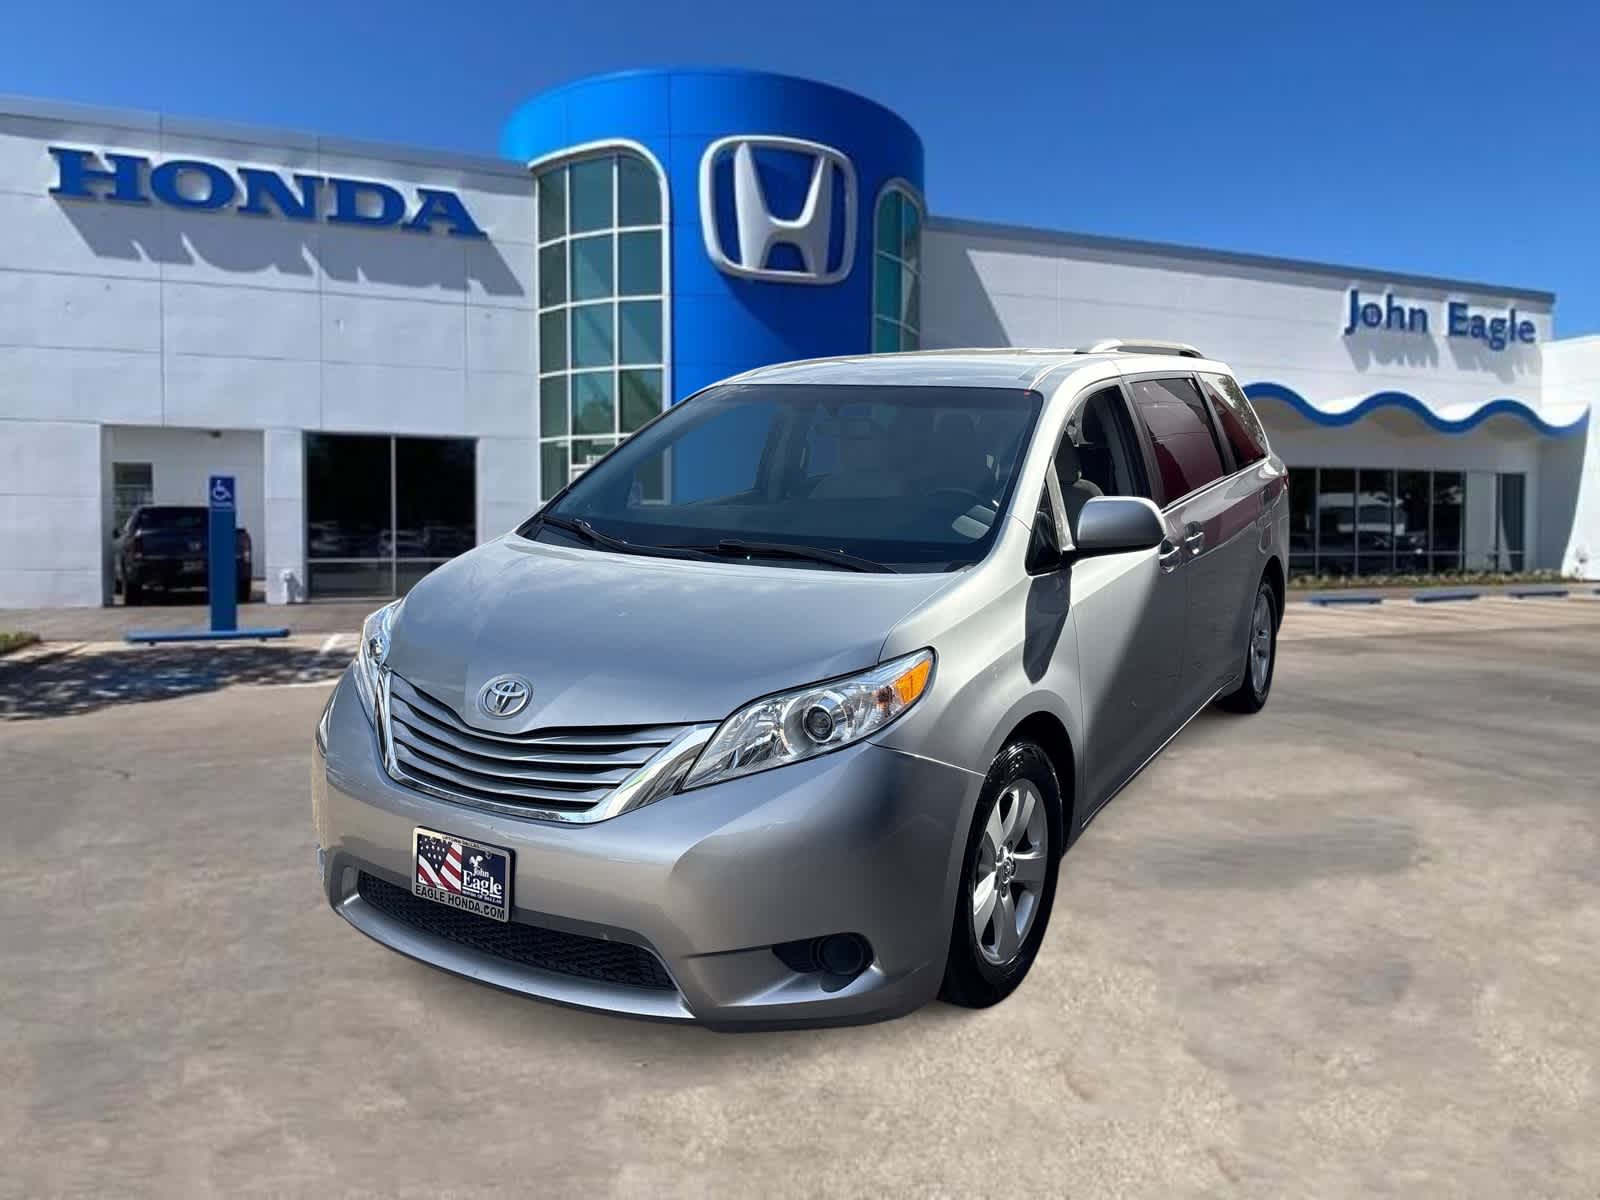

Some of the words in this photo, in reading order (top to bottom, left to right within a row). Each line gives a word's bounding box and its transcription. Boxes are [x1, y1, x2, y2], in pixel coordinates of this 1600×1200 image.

[48, 147, 488, 239] HONDA
[1344, 289, 1428, 336] John
[1449, 301, 1536, 350] Eagle
[463, 870, 502, 896] Eagle
[474, 867, 490, 878] John
[415, 885, 445, 902] EAGLE
[447, 895, 505, 920] HONDA.COM
